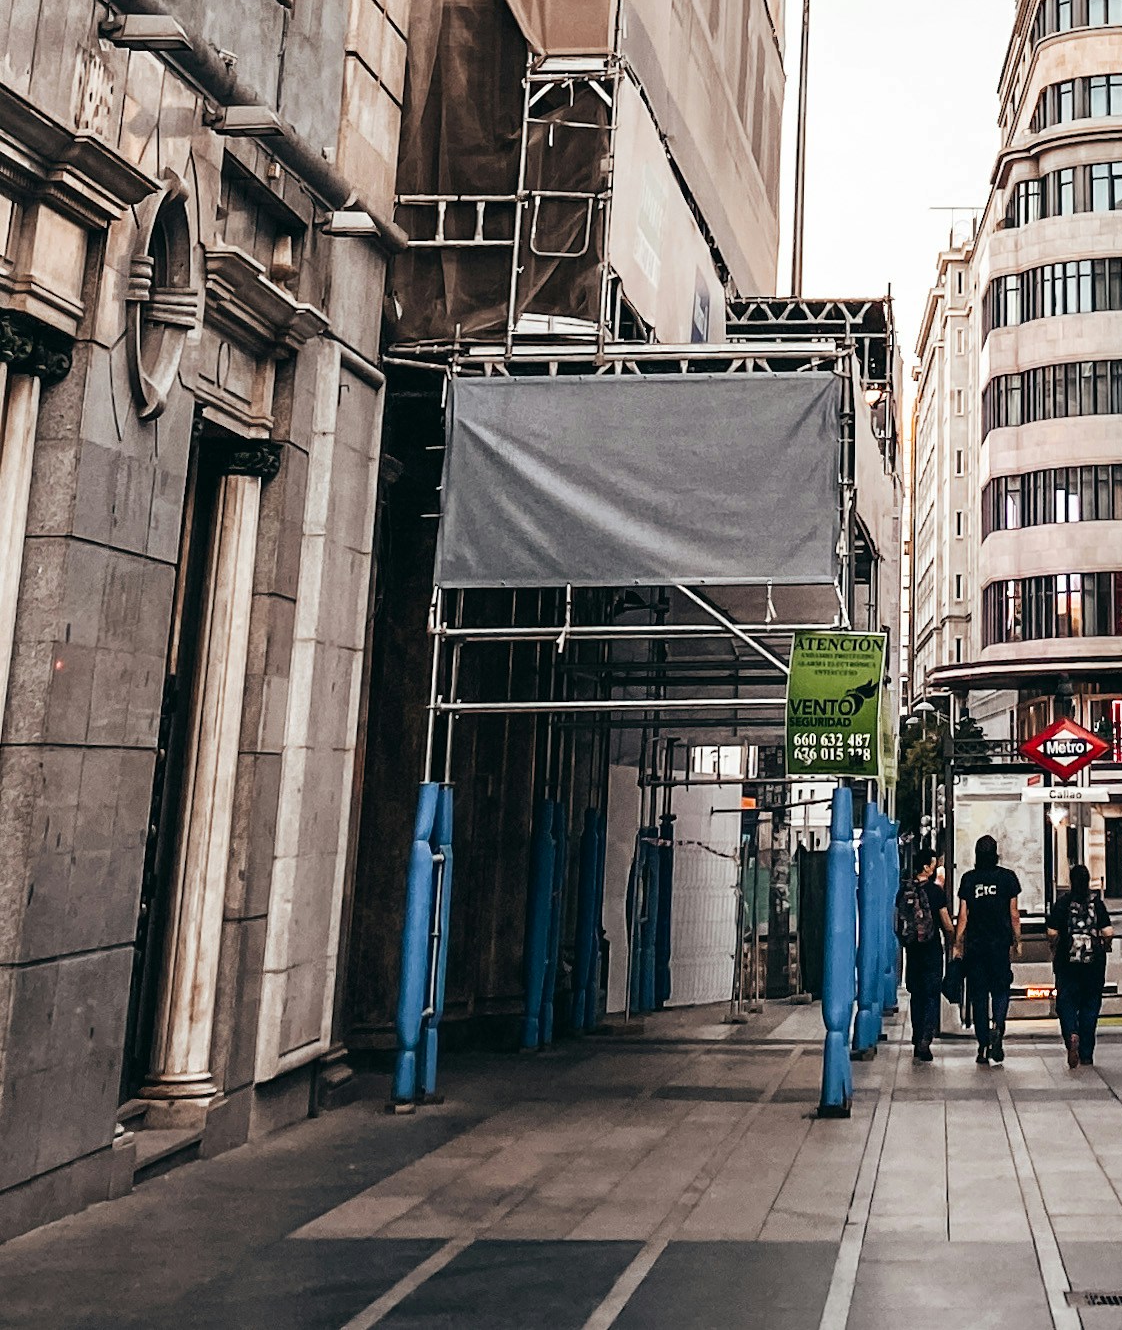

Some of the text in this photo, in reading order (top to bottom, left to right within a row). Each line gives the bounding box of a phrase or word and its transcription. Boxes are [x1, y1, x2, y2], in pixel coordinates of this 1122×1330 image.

[794, 635, 884, 652] ATENCIÓN
[788, 698, 854, 716] VENTO
[788, 716, 852, 728] SEGURIDAD
[793, 732, 871, 747] 660 632 487
[820, 747, 844, 761] 015
[1046, 741, 1085, 755] Metro
[1049, 789, 1082, 799] Callao
